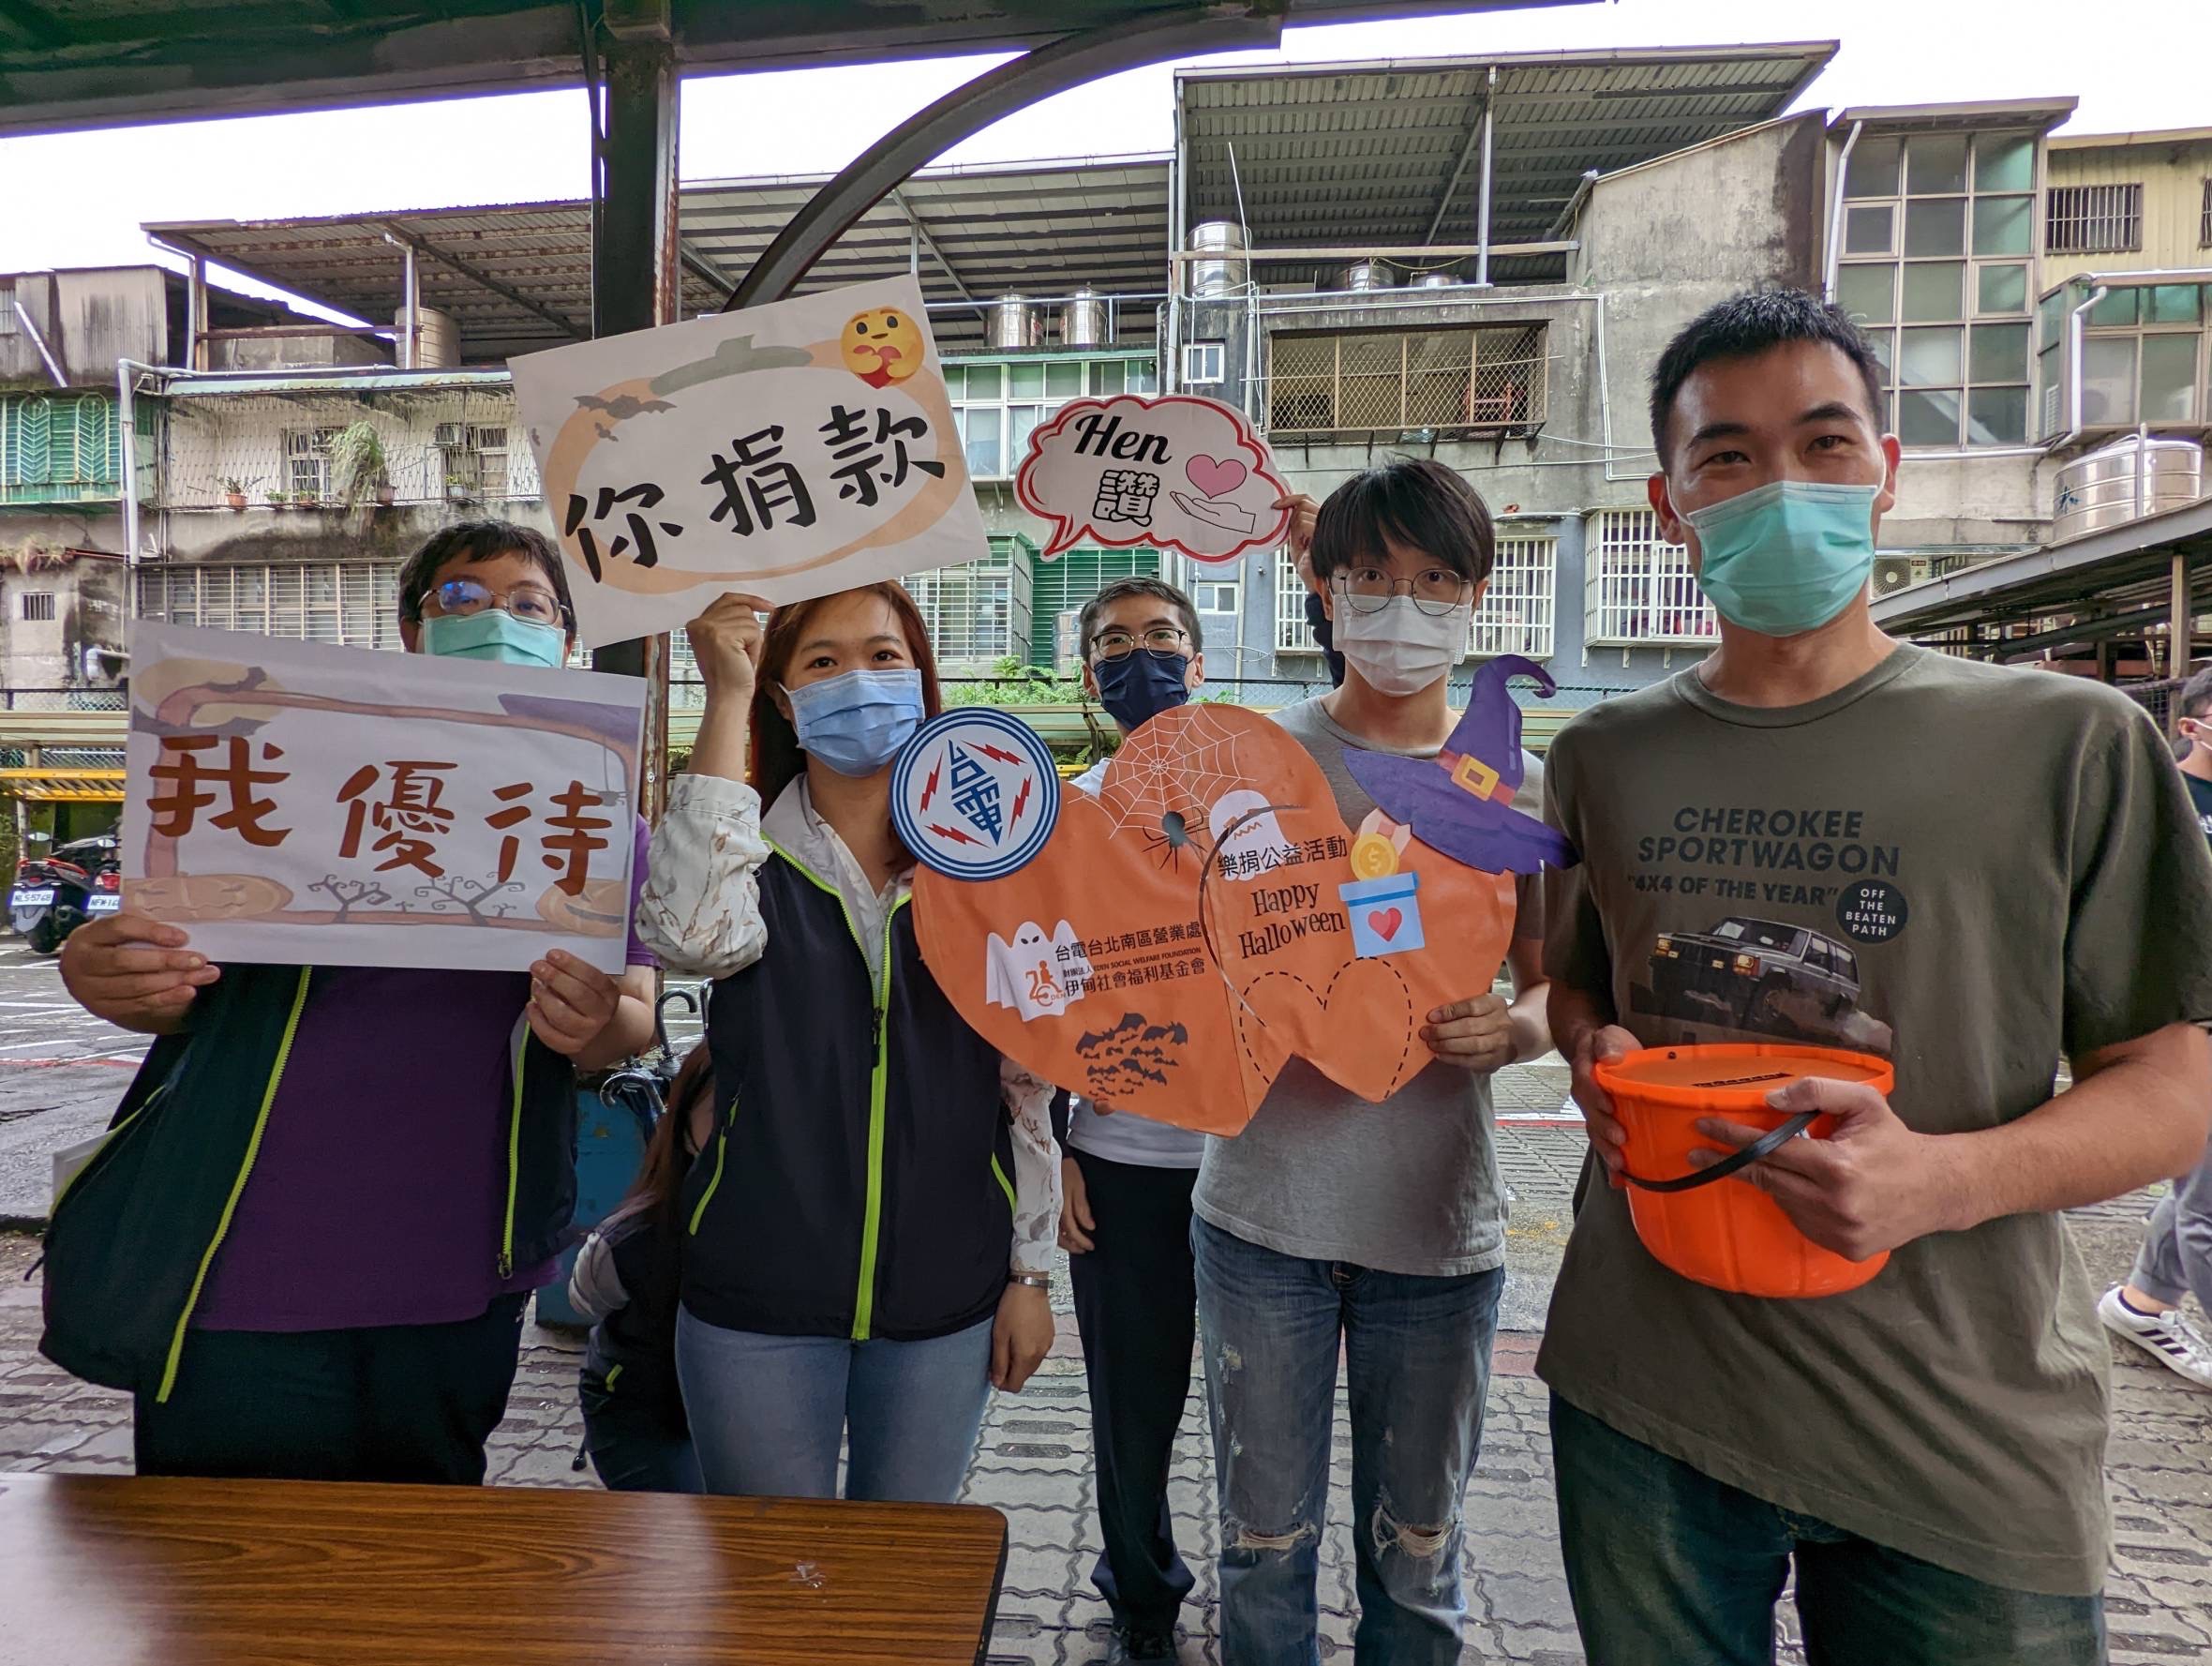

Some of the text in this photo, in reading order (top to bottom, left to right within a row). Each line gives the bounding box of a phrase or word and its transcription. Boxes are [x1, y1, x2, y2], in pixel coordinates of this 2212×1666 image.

[1075, 413, 1173, 465] Hen
[565, 403, 946, 583] 你捐款
[1092, 469, 1160, 527] 讚
[146, 734, 615, 897] 我優待
[1673, 806, 1863, 839] CHEROKEE
[1218, 834, 1348, 878] 樂捐公益活動
[1637, 836, 1900, 877] SPORTWAGON
[1250, 882, 1320, 917] Happy
[1679, 877, 1709, 894] OF
[1715, 878, 1756, 899] THE
[1860, 888, 1886, 899] OFF
[1860, 900, 1884, 911] THE
[1238, 910, 1346, 960] Halloween
[1846, 911, 1896, 925] BEATEN
[1852, 924, 1888, 937] PATH
[1055, 922, 1203, 962] 台電台北南區營業處
[1094, 963, 1110, 971] EDEN
[1111, 958, 1131, 968] SOCIAL
[1133, 953, 1160, 965] WELFARE
[1162, 947, 1201, 960] FOUNDATION
[1065, 957, 1205, 998] 伊甸社會福利基金會
